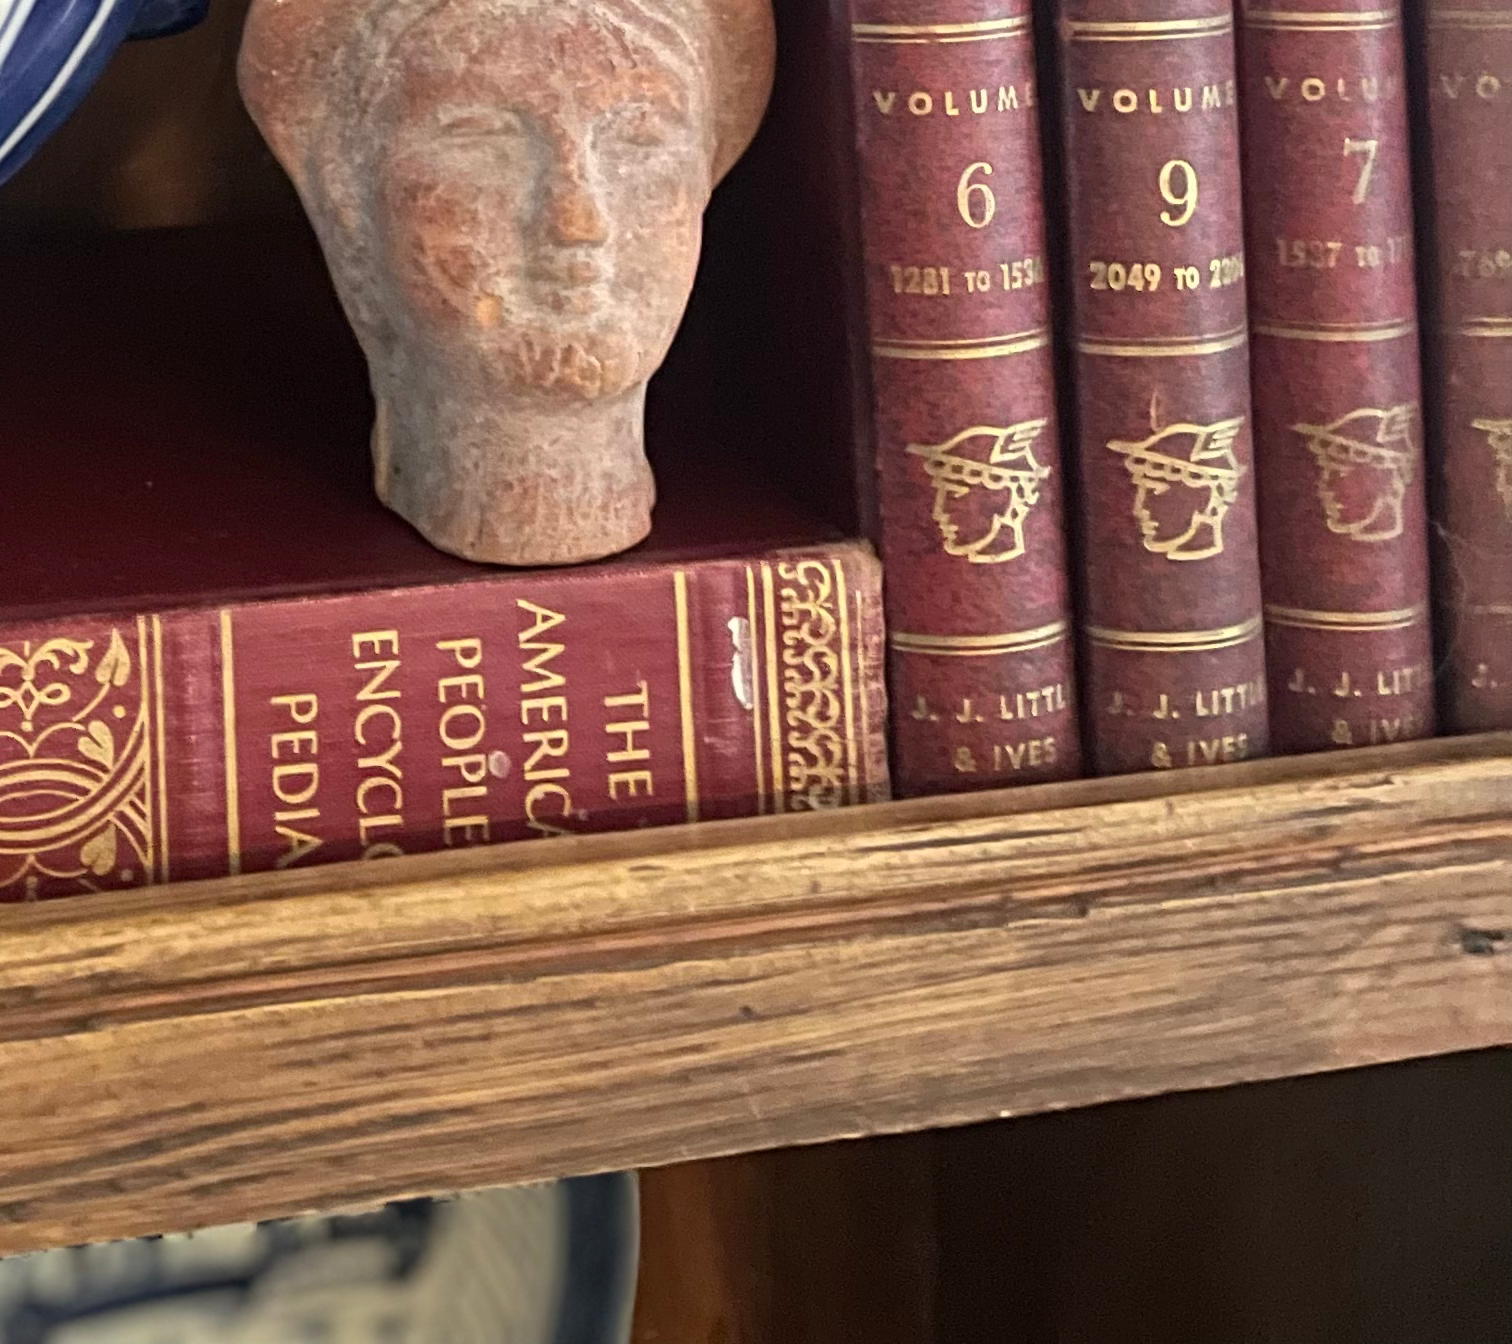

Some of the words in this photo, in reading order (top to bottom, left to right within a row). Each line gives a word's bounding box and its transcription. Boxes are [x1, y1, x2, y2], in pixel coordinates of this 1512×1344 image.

[1076, 79, 1234, 113] VOLUME
[1264, 75, 1388, 102] VOLU
[1343, 137, 1379, 205] 7
[957, 162, 996, 228] 6
[1158, 159, 1199, 227] 9
[891, 265, 950, 296] 1281
[964, 269, 990, 294] TO
[1088, 262, 1162, 292] 2049
[1173, 265, 1200, 291] TO
[1333, 671, 1362, 697] J.
[955, 698, 985, 724] J.
[999, 683, 1068, 721] LITTL
[1152, 694, 1181, 720] J.
[435, 636, 490, 847] PEOPLE
[603, 679, 655, 800] THE
[953, 745, 977, 773] &
[992, 736, 1057, 772] IVES
[1150, 741, 1172, 769] &
[1187, 733, 1249, 766] IVES
[270, 693, 325, 869] PEDIA
